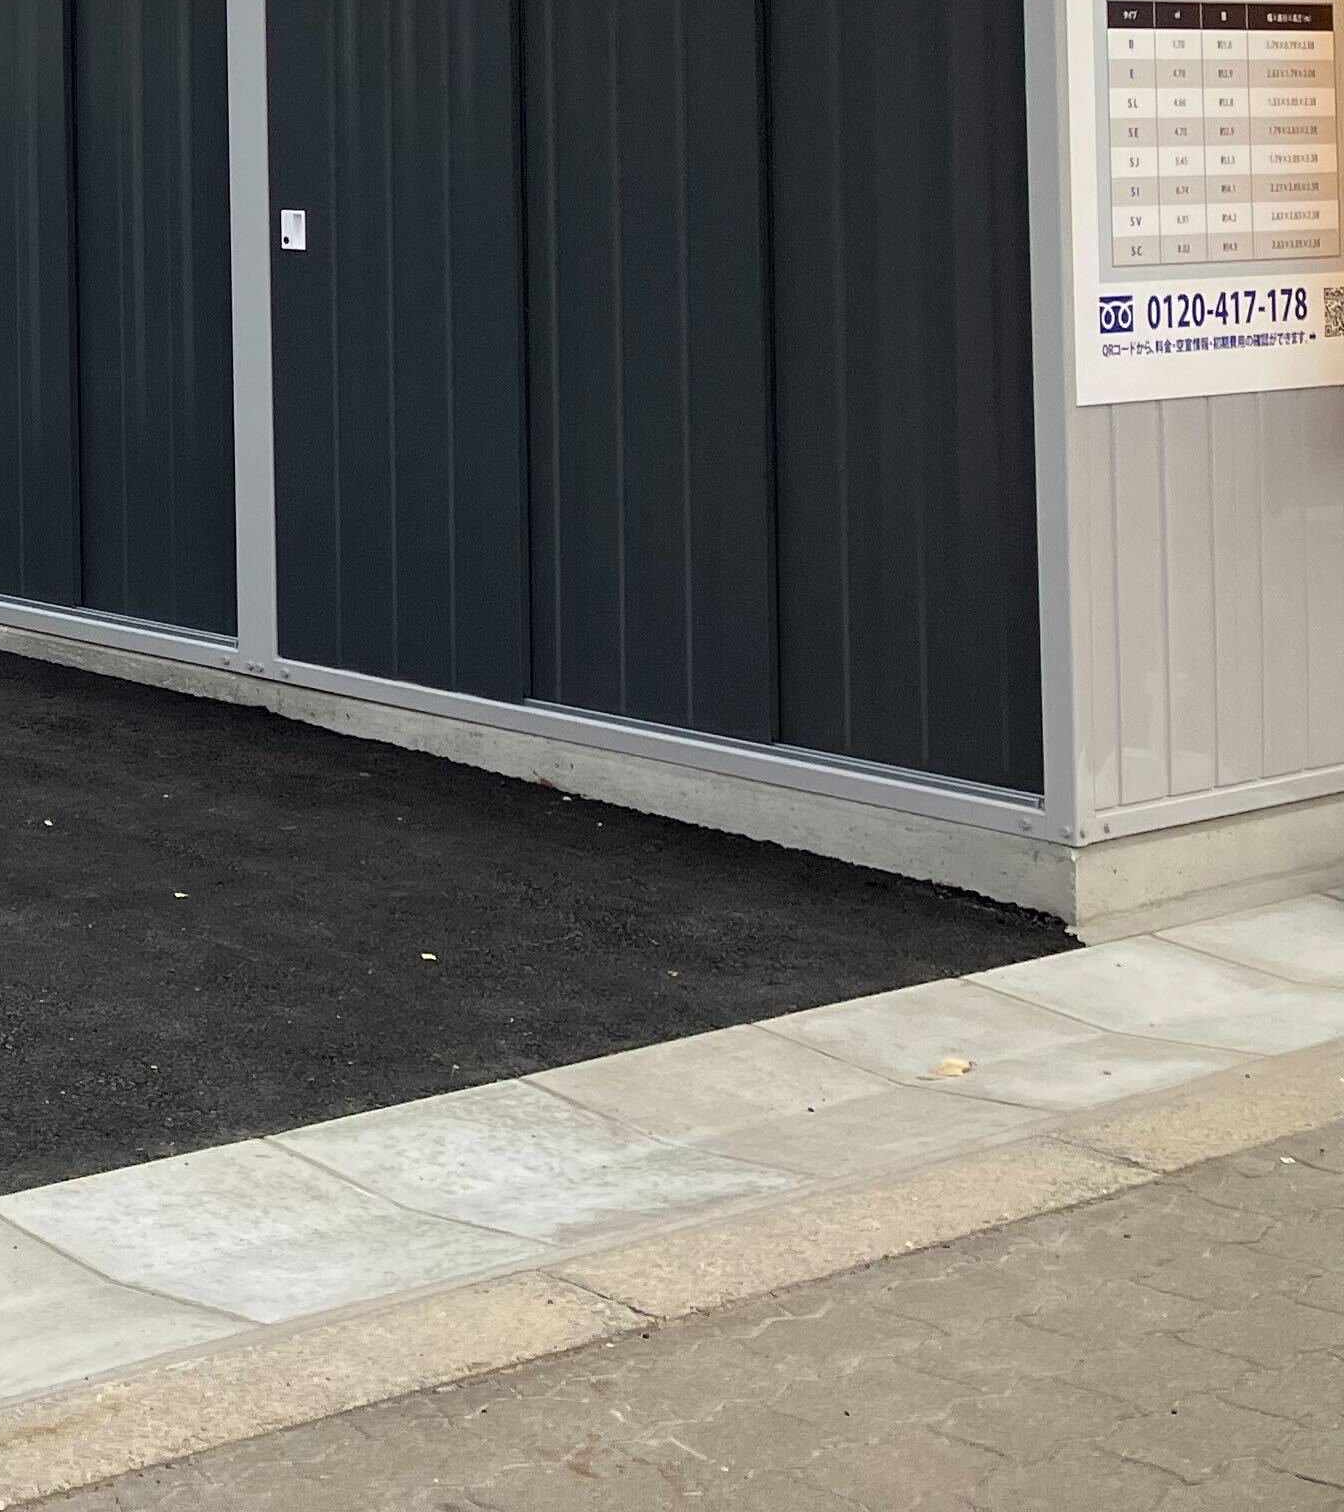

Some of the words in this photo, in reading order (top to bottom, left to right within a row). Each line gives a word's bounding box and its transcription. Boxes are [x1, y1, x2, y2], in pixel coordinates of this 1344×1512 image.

[1127, 97, 1139, 109] SL
[1128, 127, 1139, 138] SE
[1129, 157, 1140, 168] SJ
[1130, 187, 1140, 198] SI
[1130, 216, 1142, 227] SV
[1131, 245, 1143, 257] SC
[1147, 287, 1308, 329] 0120-417-178
